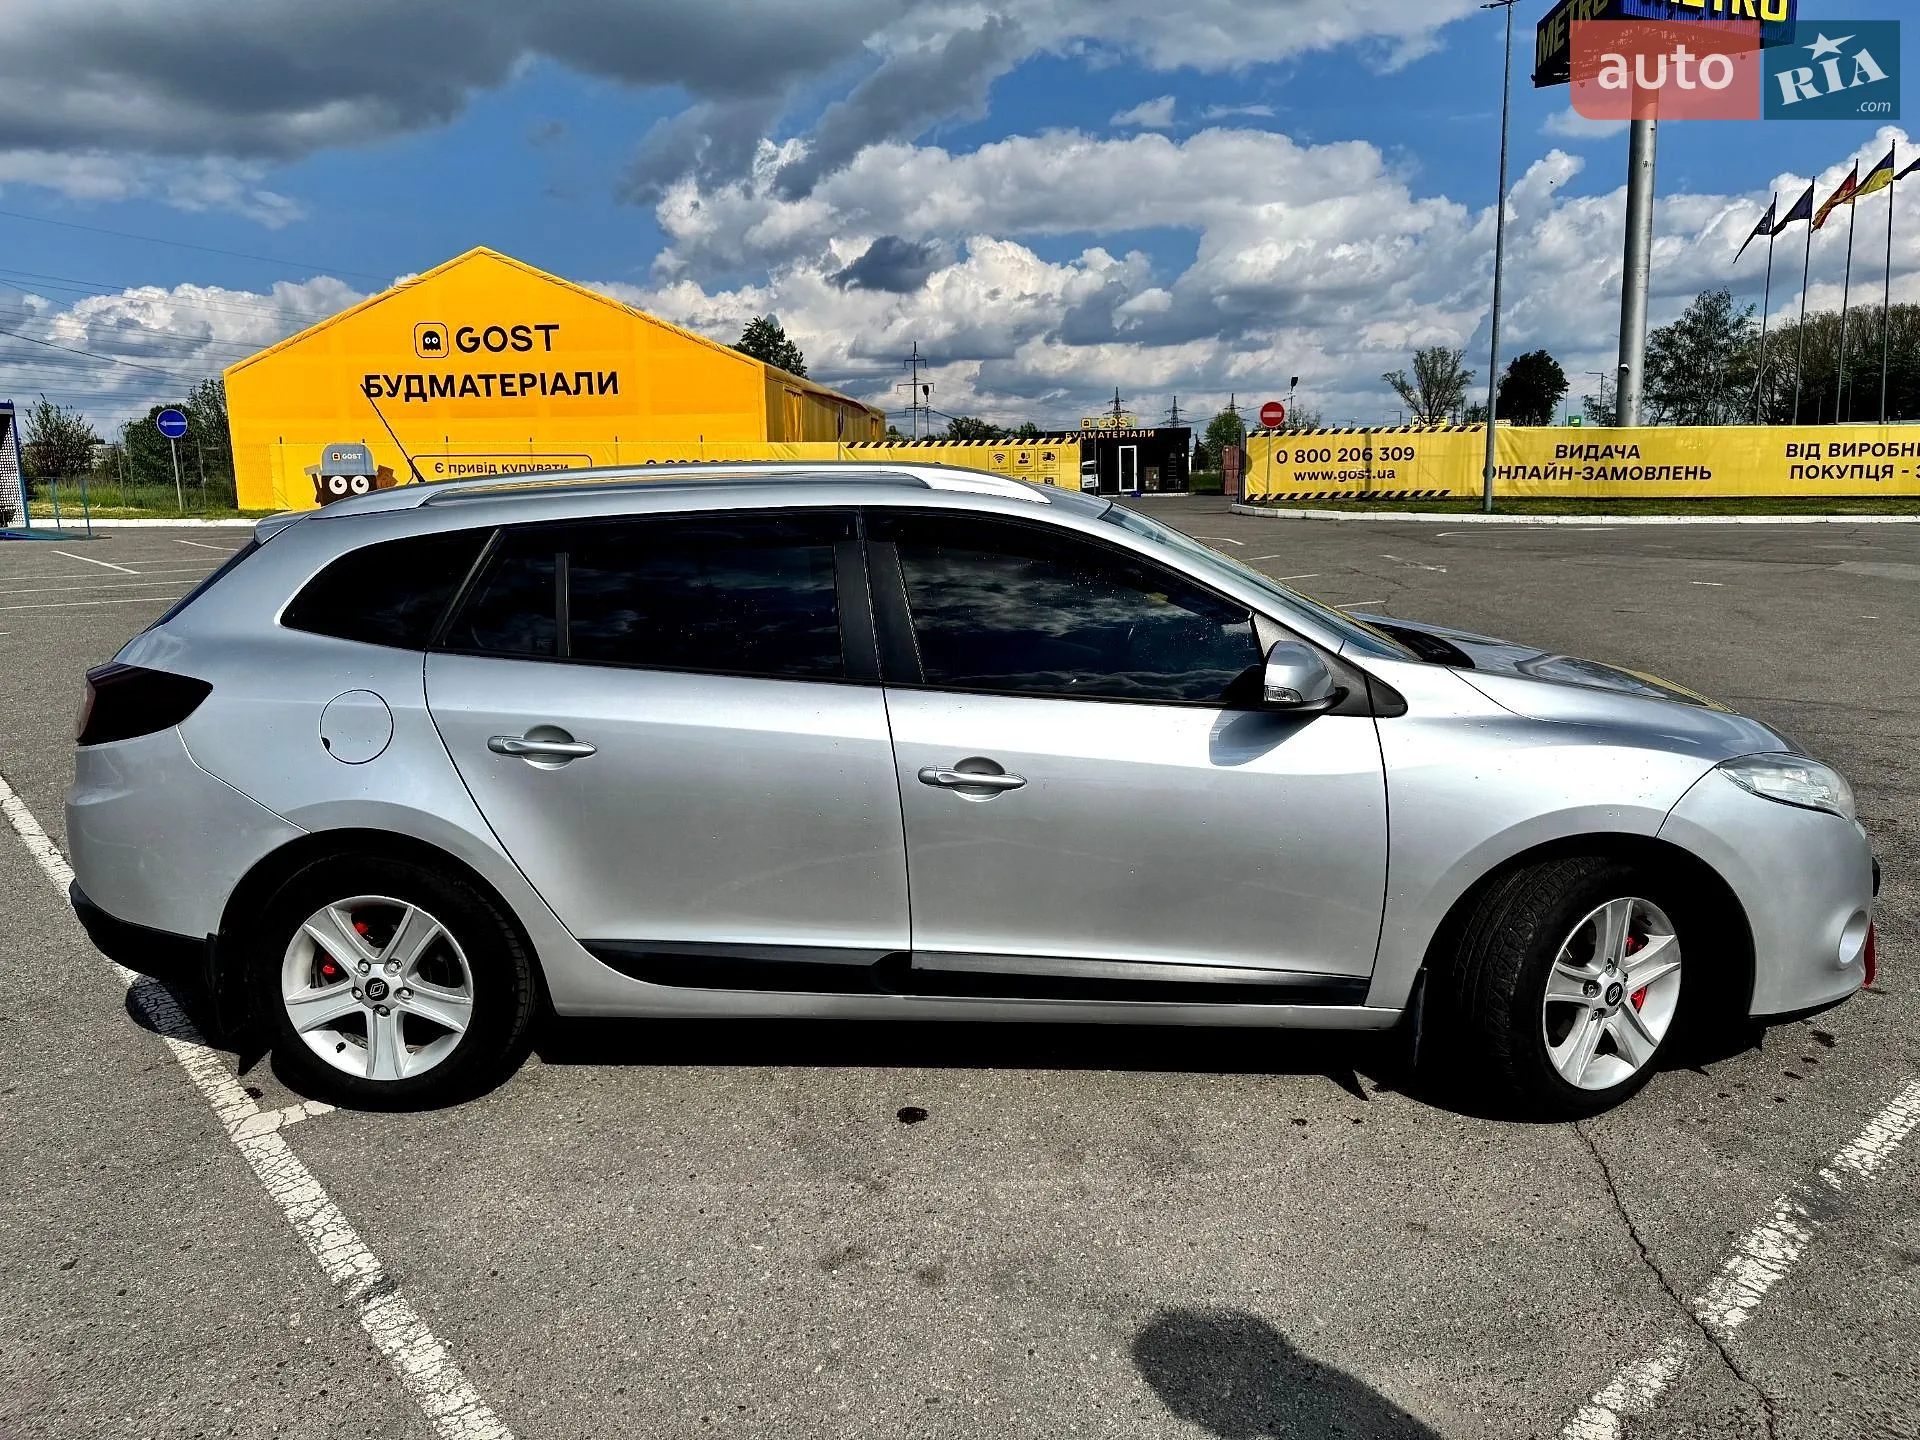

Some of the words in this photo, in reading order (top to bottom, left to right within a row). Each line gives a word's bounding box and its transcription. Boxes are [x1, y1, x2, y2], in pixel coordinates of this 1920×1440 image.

[455, 324, 560, 353] GOST
[363, 371, 619, 403] БУДМАТЕРІАЛИ
[1276, 450, 1288, 464] 0
[1294, 449, 1331, 463] 800
[1337, 448, 1373, 462] 206
[1379, 447, 1415, 461] 309
[1555, 444, 1641, 461] ВИДАЧА
[1785, 443, 1821, 461] ВІД
[1828, 442, 1920, 458] ВИРОБН
[434, 462, 444, 473] Є
[448, 462, 498, 475] привід
[1294, 468, 1396, 482] www.gost.ua
[1789, 464, 1894, 482] ПОКУПЦЯ
